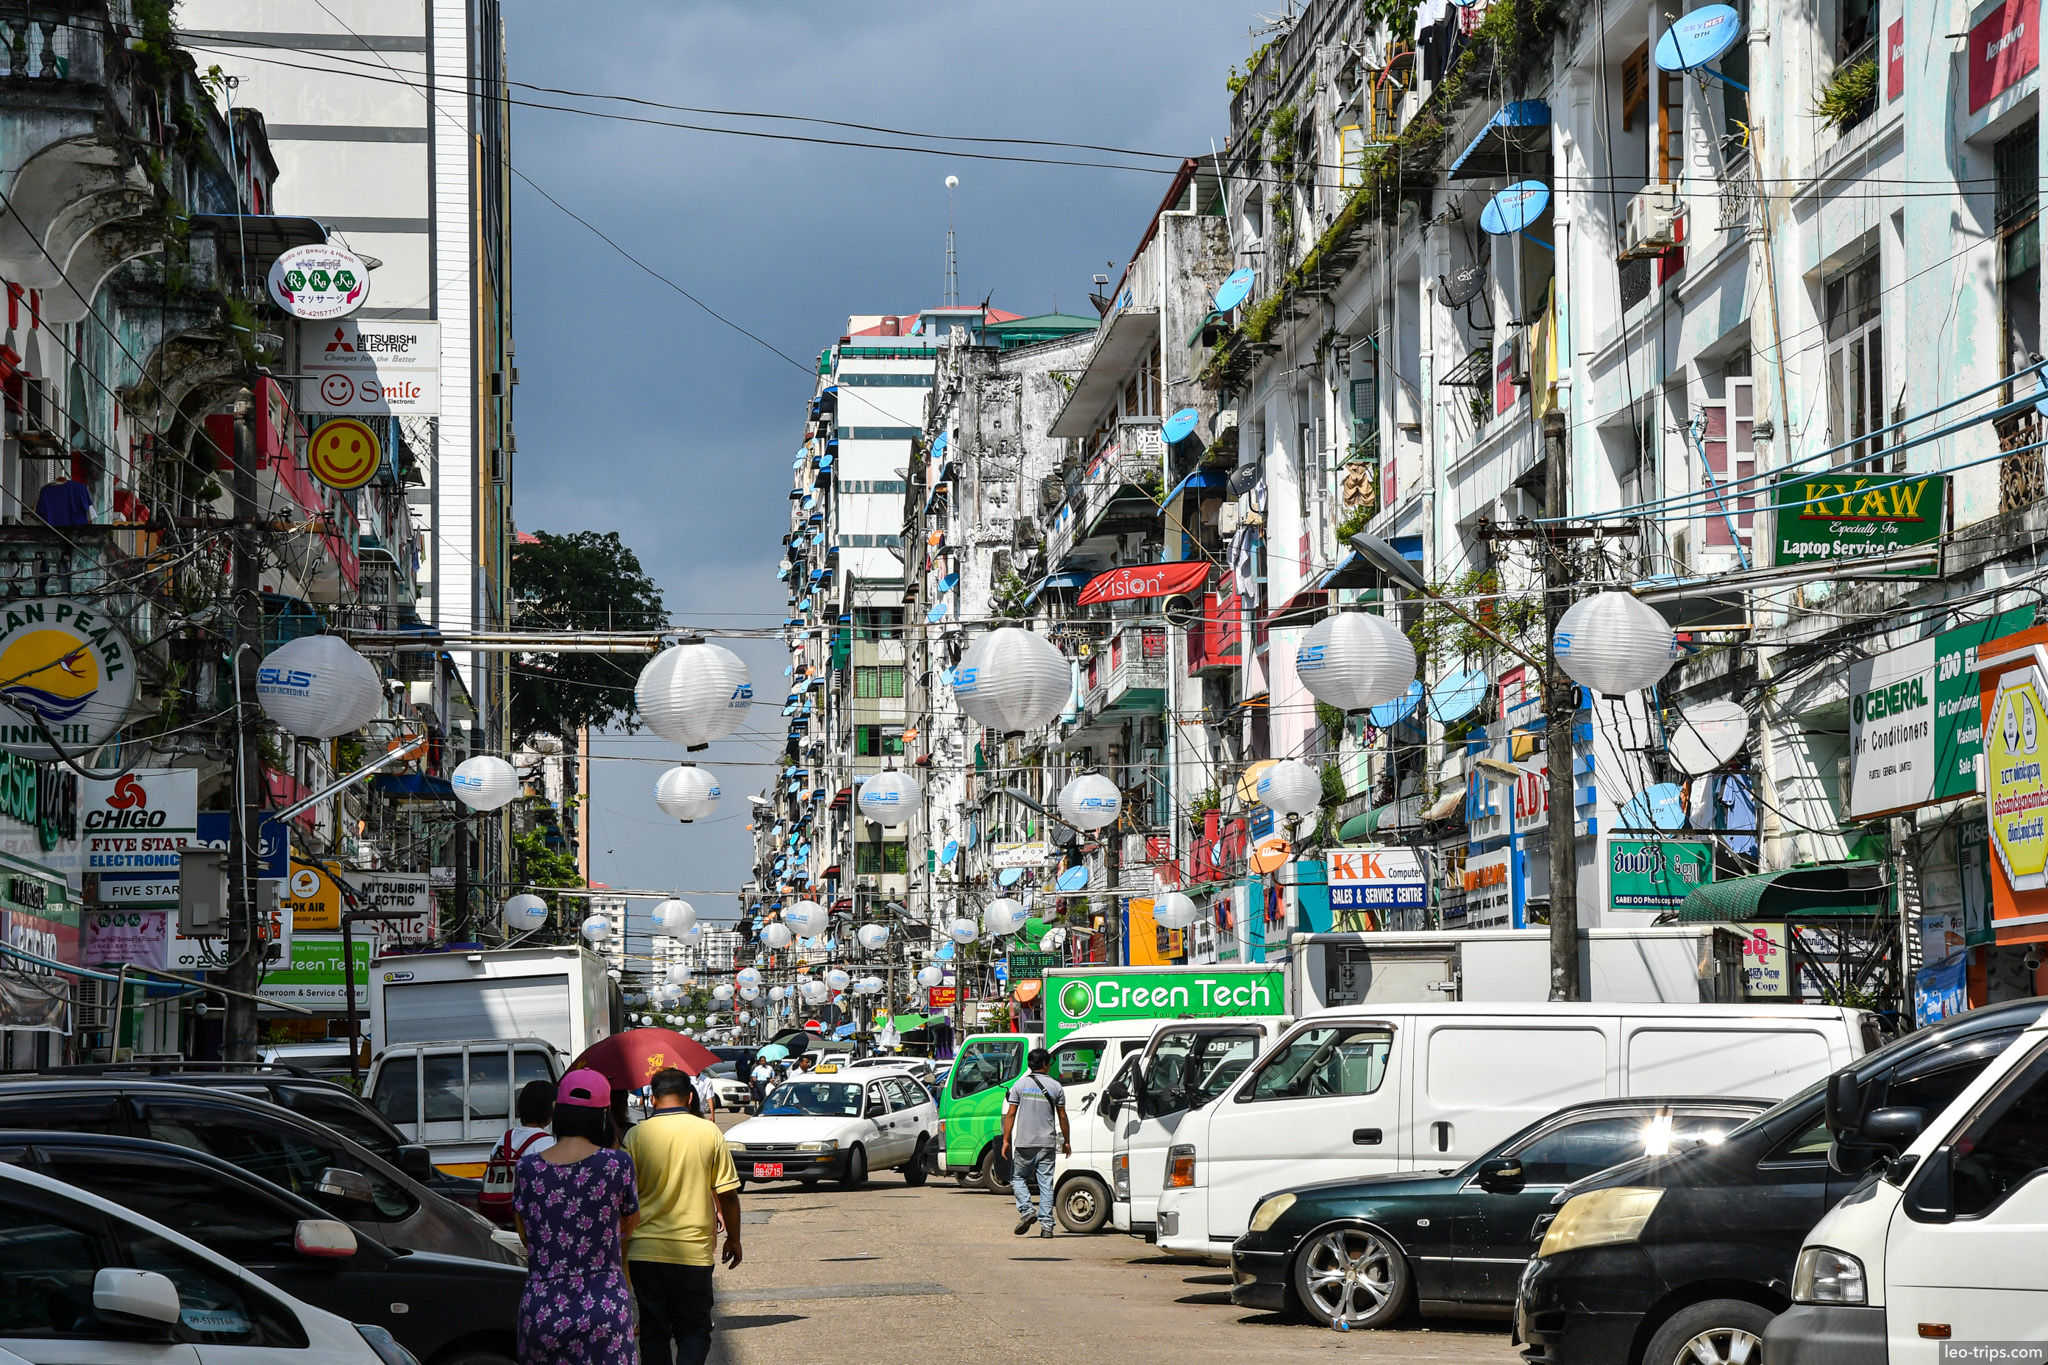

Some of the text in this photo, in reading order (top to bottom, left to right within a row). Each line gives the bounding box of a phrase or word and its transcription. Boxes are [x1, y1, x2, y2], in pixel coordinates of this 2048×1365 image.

[1986, 22, 2025, 61] lenovo
[335, 251, 355, 264] Health
[297, 294, 344, 303] マッサージ
[357, 334, 417, 344] MITSUBISHI
[357, 343, 409, 352] ELECTRIC
[324, 353, 357, 363] Changes
[361, 353, 373, 362] for
[392, 355, 416, 363] Better
[360, 380, 421, 402] Smile
[1803, 478, 1929, 517] KYAW
[1829, 521, 1898, 536] Especially For
[1783, 540, 1831, 558] Laptop
[1833, 540, 1887, 555] Service
[56, 603, 124, 682] PEARL
[1939, 651, 1961, 682] 200
[257, 668, 312, 687] SUS
[278, 687, 309, 697] INCREDIBLE
[1865, 676, 1928, 722] GENERAL
[1938, 694, 1980, 718] Air Conditioner
[1854, 721, 1928, 756] Air Conditioners
[1957, 726, 1980, 744] Washing
[1959, 755, 1972, 775] Sale
[2001, 769, 2013, 785] ICT
[862, 792, 899, 801] ASUS
[1080, 798, 1117, 808] ASUS
[85, 810, 167, 828] CHIGO
[91, 838, 137, 852] FIVE
[141, 838, 188, 852] STAR
[1332, 853, 1421, 880] KK Computer
[112, 885, 180, 897] FIVE STAR
[361, 883, 425, 894] MITSUBISHI
[1332, 887, 1422, 904] SALES & SERVICE CENTRE
[308, 903, 325, 912] AIR
[361, 895, 415, 906] ELECTRIC
[1616, 896, 1633, 904] SABEI
[290, 958, 365, 971] reen Teh
[258, 989, 364, 998] howroom & Service Ceter
[1095, 980, 1270, 1008] Green Tech
[1756, 982, 1779, 991] Copy
